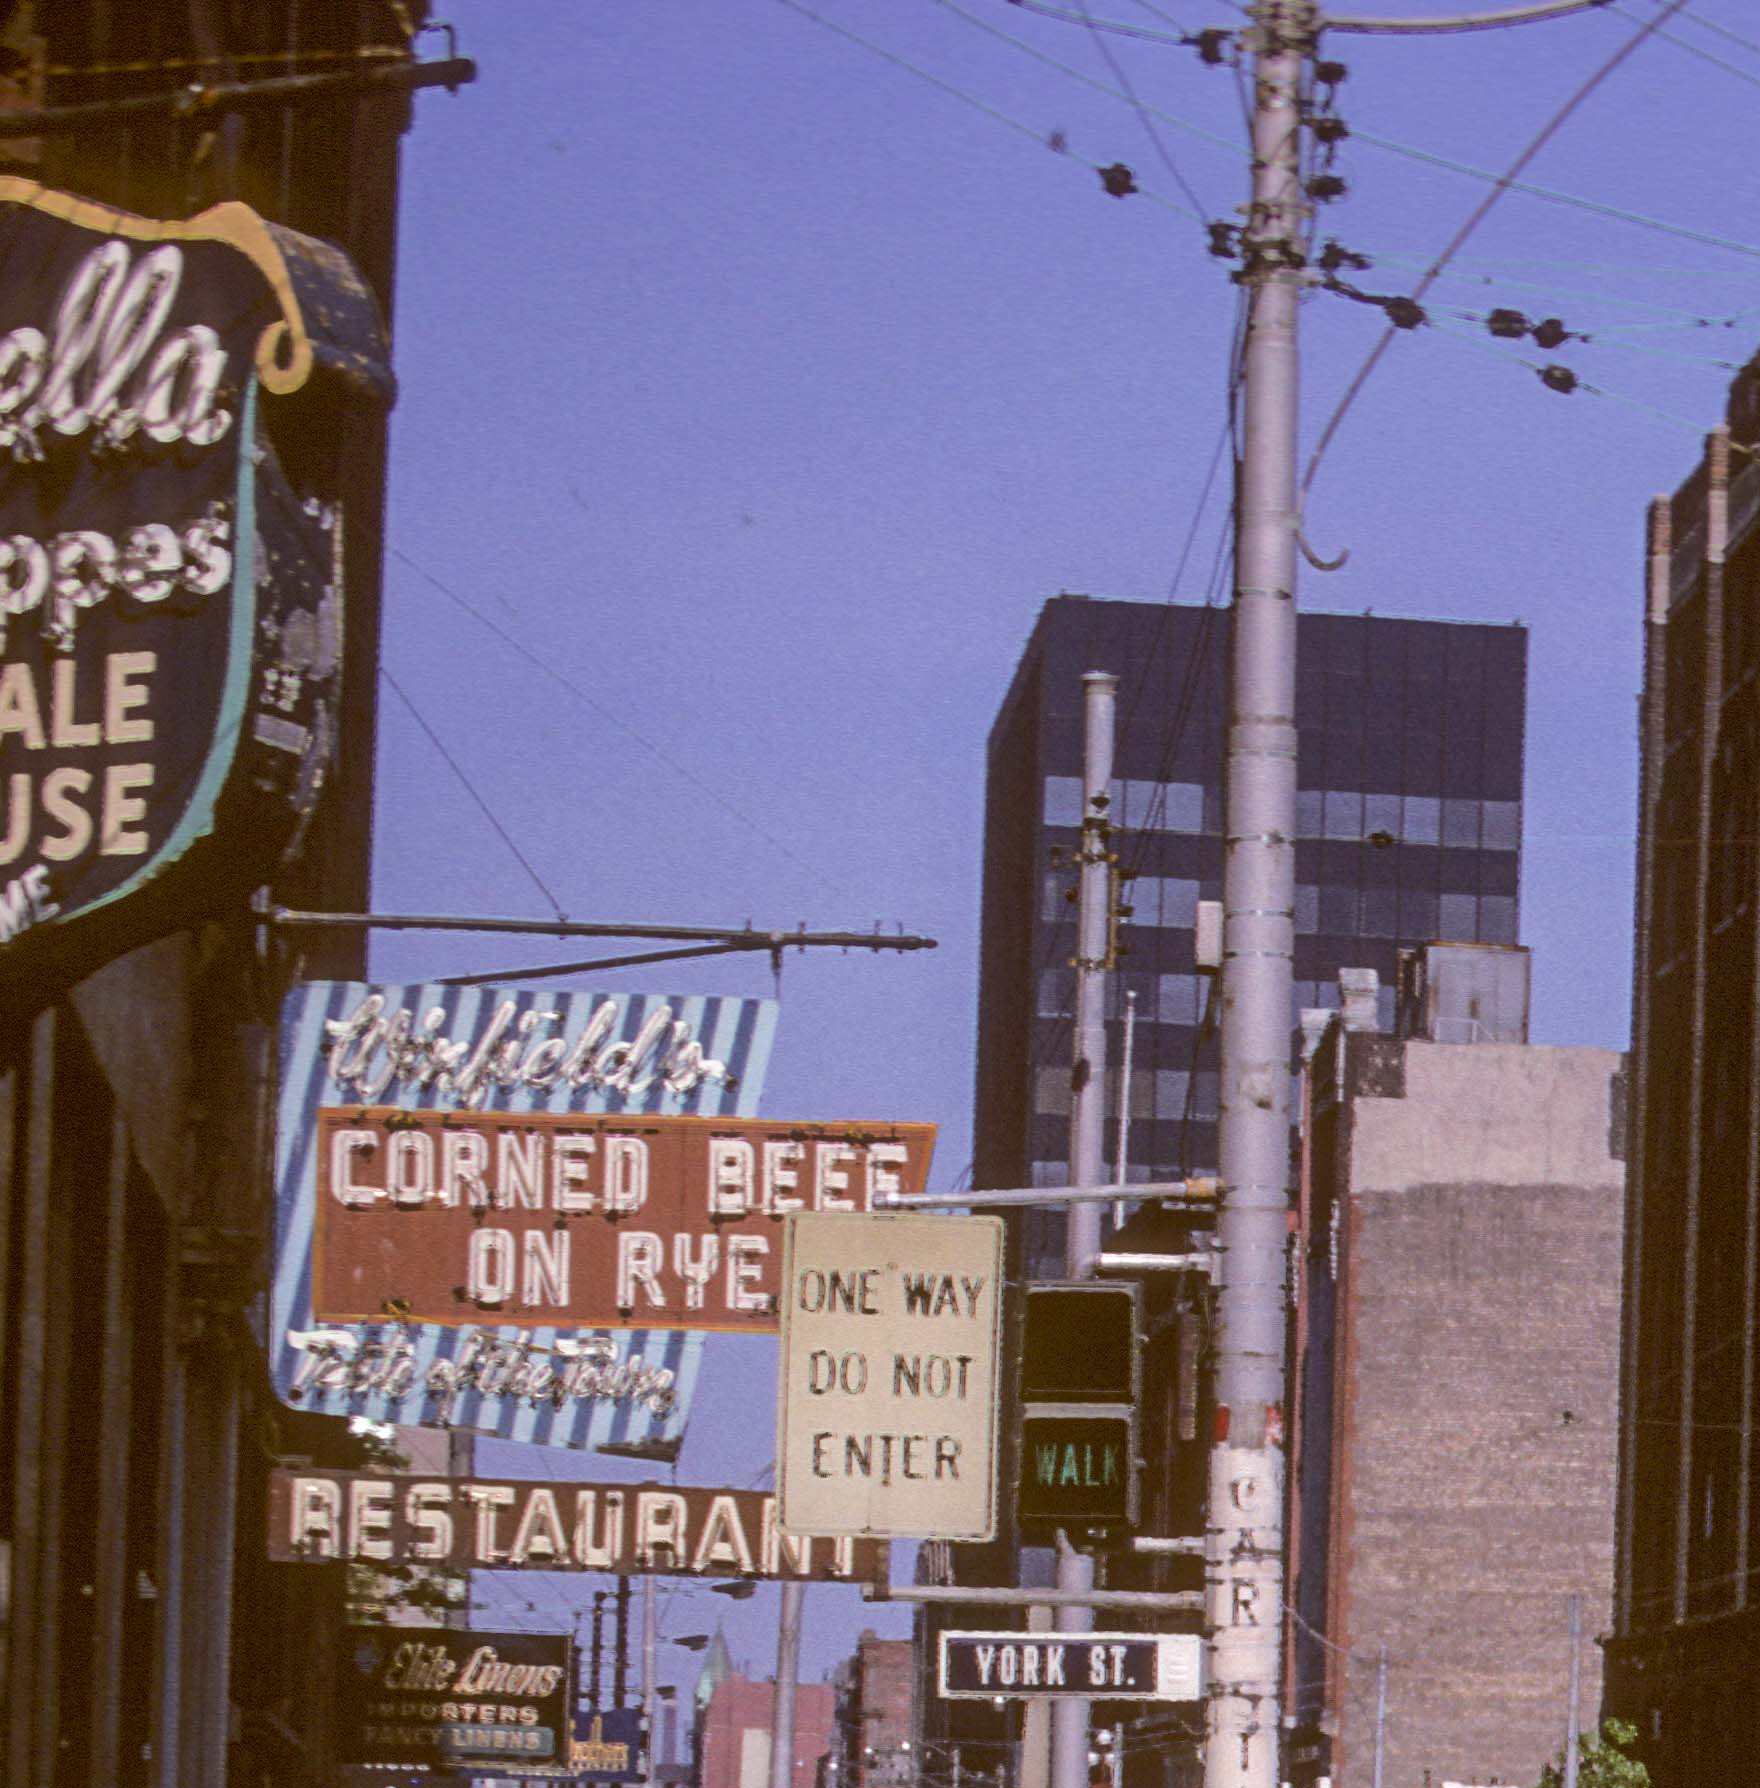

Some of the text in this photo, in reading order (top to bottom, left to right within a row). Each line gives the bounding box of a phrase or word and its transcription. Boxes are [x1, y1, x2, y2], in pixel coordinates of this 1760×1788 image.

[330, 1129, 909, 1213] CORNED BEEF
[467, 1229, 770, 1311] ON RYE
[800, 1268, 985, 1320] ONE WAY
[808, 1350, 974, 1400] DO NOT
[812, 1432, 962, 1482] ENTER
[1035, 1444, 1120, 1487] WALK
[452, 1645, 564, 1698] Linens
[975, 1643, 1136, 1687] YORK ST.
[452, 1728, 542, 1750] LINENS
